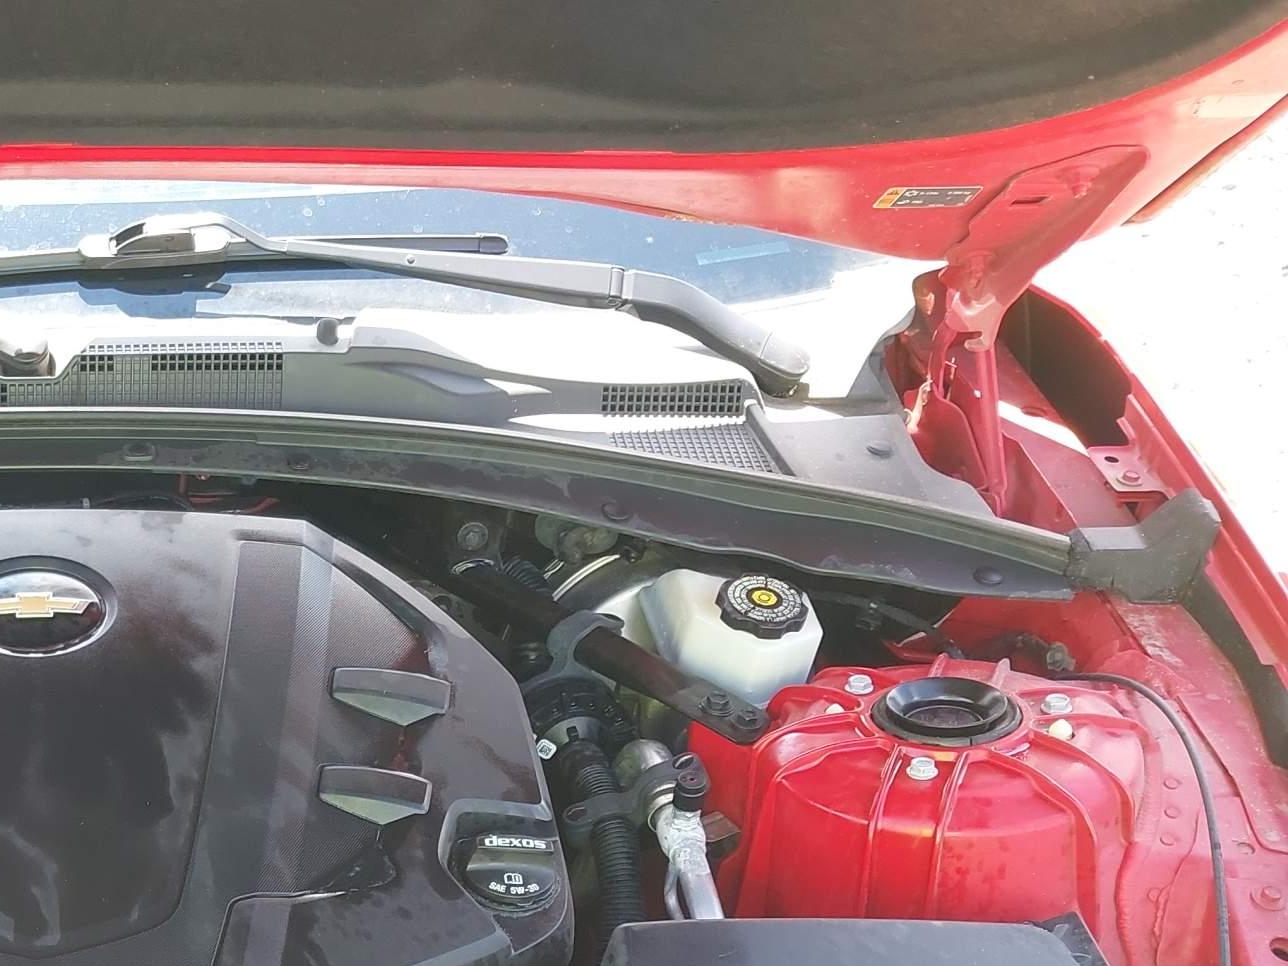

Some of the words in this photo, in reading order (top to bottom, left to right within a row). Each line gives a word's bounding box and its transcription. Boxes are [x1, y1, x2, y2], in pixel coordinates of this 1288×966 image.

[484, 834, 547, 849] dexos
[488, 881, 507, 893] SAE
[509, 883, 540, 895] 5W-30
